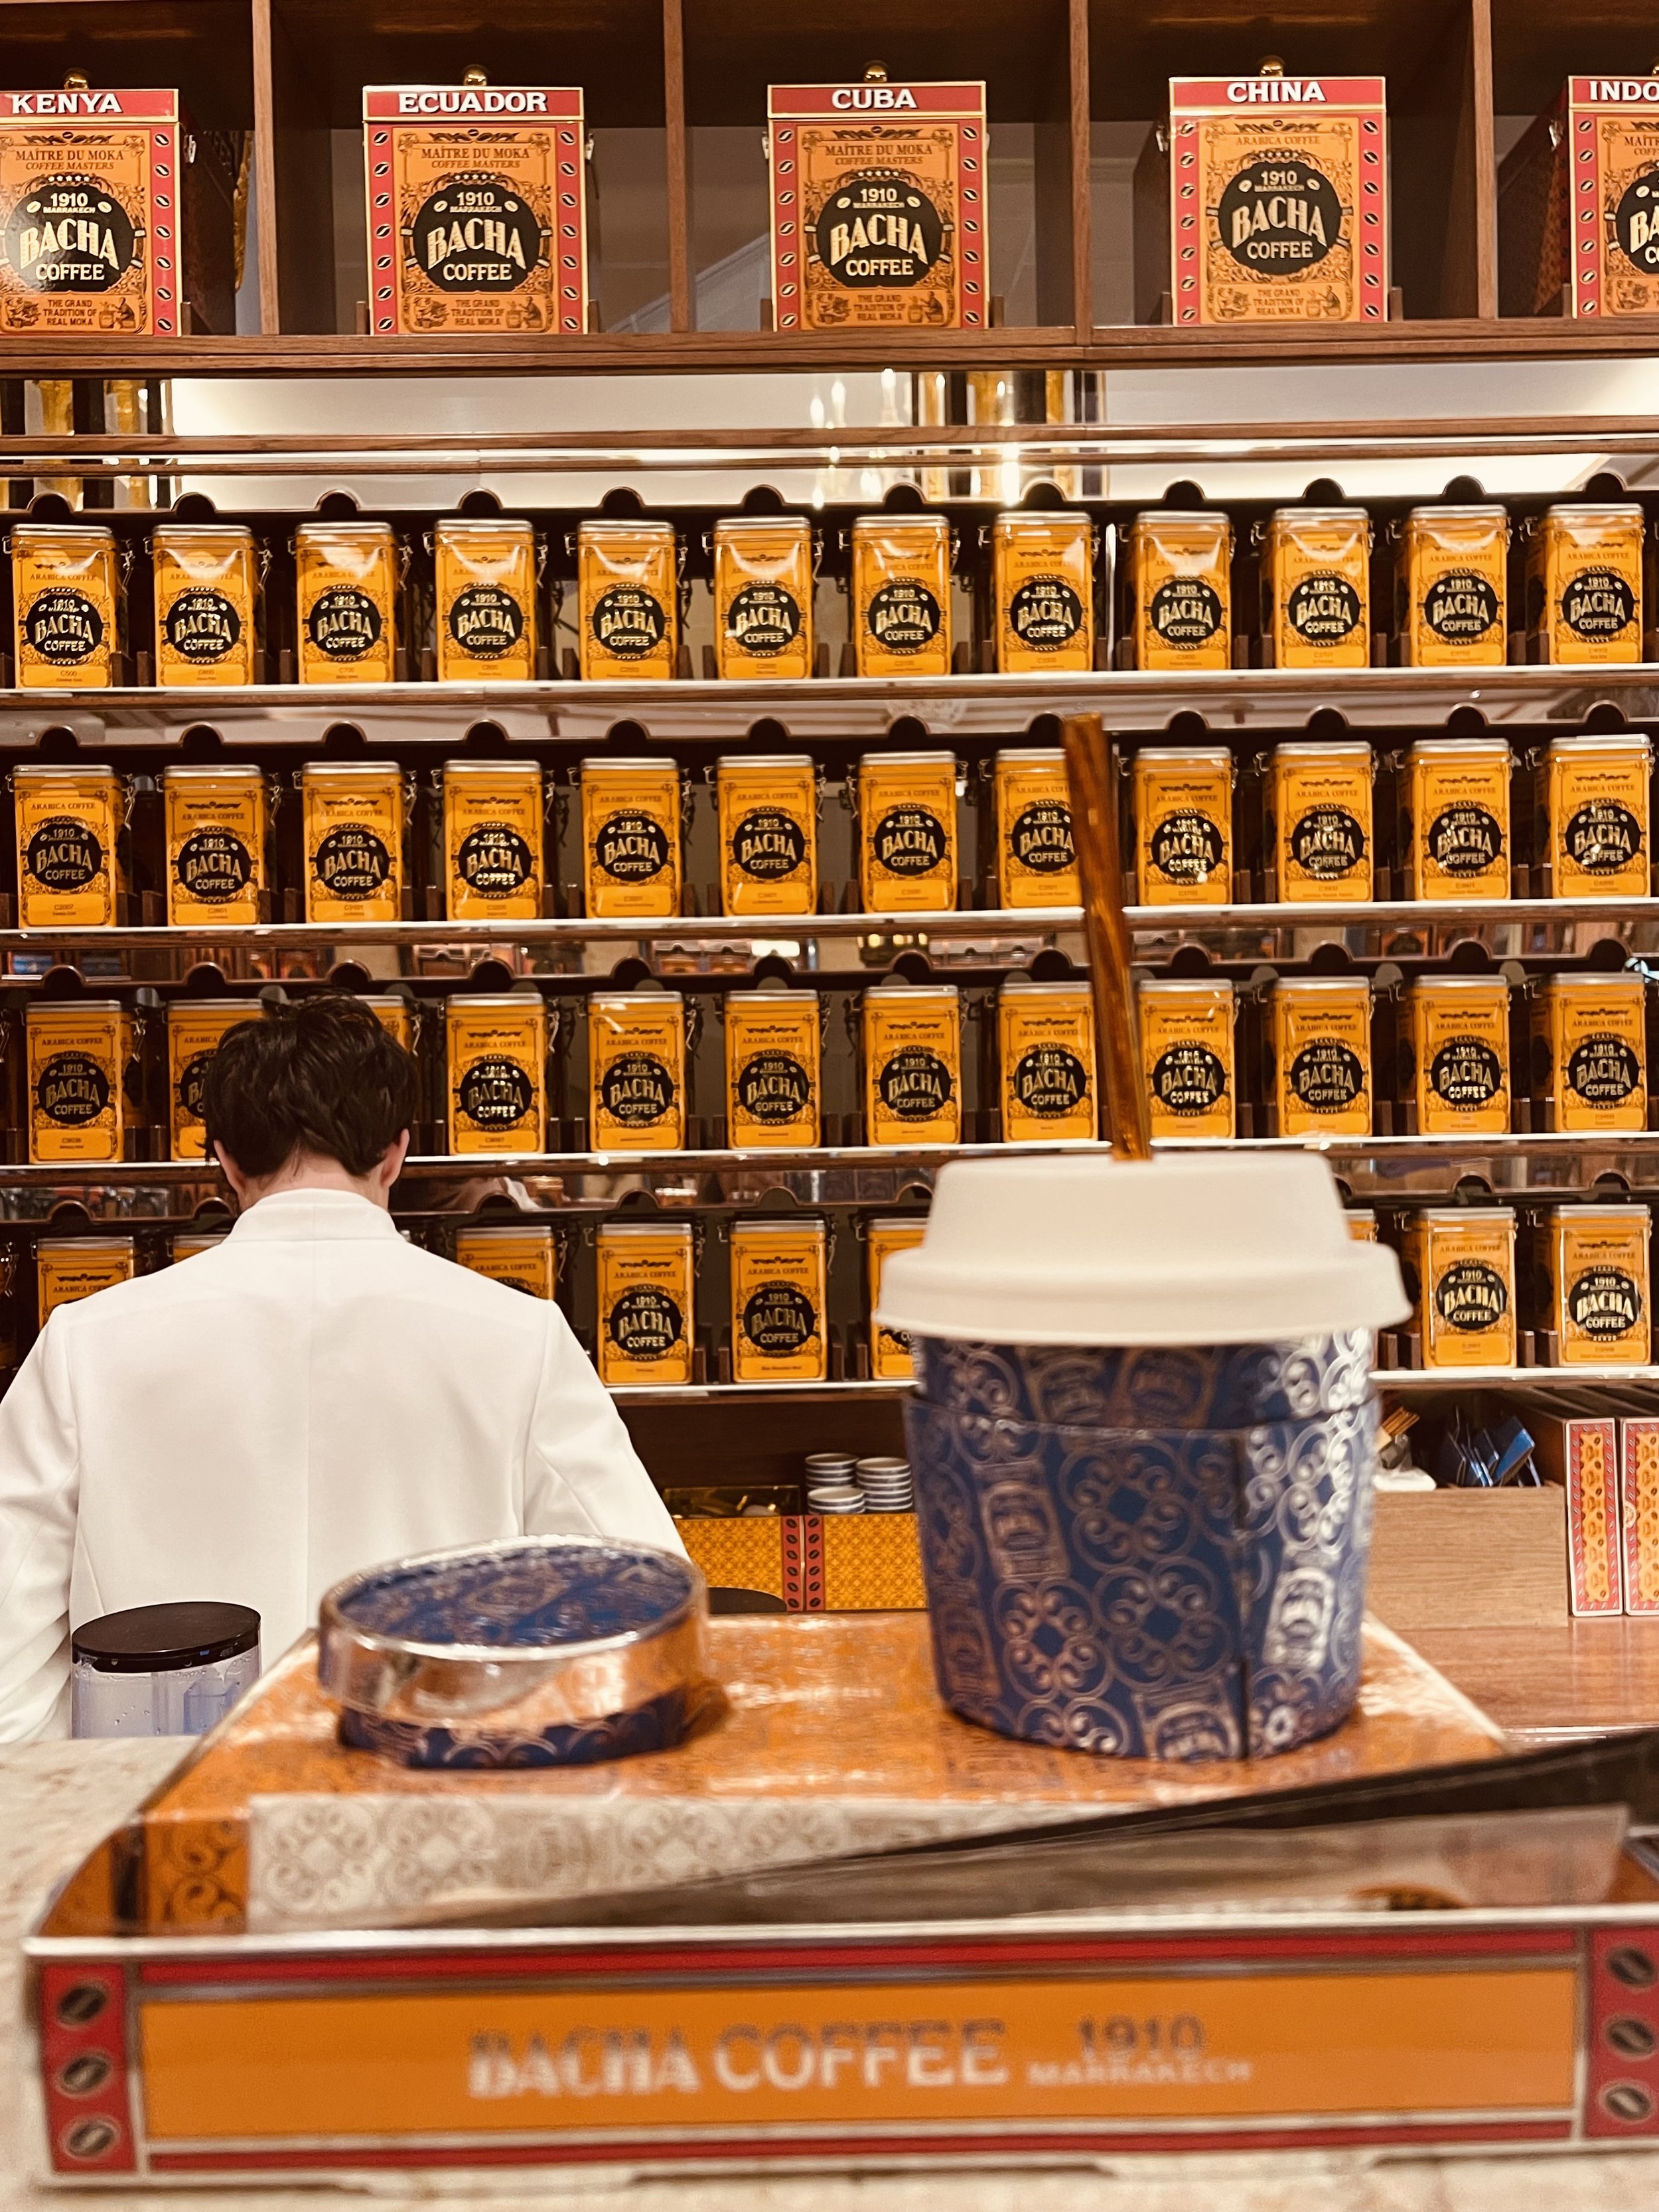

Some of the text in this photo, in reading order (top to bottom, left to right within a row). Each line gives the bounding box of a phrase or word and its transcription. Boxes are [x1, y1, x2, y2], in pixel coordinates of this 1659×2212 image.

[1227, 81, 1326, 102] CHINA
[12, 93, 122, 114] KENYA
[398, 92, 547, 113] ECUADOR
[831, 89, 917, 110] CUBA
[1236, 135, 1321, 145] ARABICA COFFEE
[15, 148, 124, 161] MAÎTRE DU MOKA
[421, 146, 530, 159] MAÎTRE DU MOKA
[825, 143, 932, 156] MAÎTRE DU MOKA
[25, 161, 114, 171] COFFEE MASTERS
[431, 160, 520, 169] COFFEE MASTERS
[875, 156, 924, 165] MASTERS
[1261, 171, 1297, 185] 1910
[50, 192, 88, 206] 1910
[457, 192, 495, 206] 1910
[860, 188, 897, 202] 1910
[1232, 196, 1327, 249] BACHA
[20, 218, 119, 270] BACHA
[427, 218, 527, 270] BACHA
[830, 214, 928, 265] BACHA
[1246, 241, 1313, 259] COFFEE
[36, 263, 105, 281] COFFEE
[443, 263, 512, 281] COFFEE
[845, 259, 914, 276] COFFEE
[1257, 289, 1271, 297] THE
[48, 299, 93, 308] THE GRAND
[455, 299, 500, 308] THE GRAND
[1295, 298, 1305, 307] OF
[42, 309, 97, 317] TRADITION OF
[451, 309, 505, 317] TRADITION OF
[474, 593, 497, 603] 1910
[893, 589, 914, 598] 1910
[1296, 597, 1352, 626] BACHA
[1433, 594, 1488, 626] BACHA
[1570, 592, 1625, 621] BACHA
[876, 604, 932, 632] BACHA
[1018, 601, 1074, 632] BACHA
[1159, 600, 1213, 630] BACHA
[317, 612, 372, 644] BACHA
[457, 609, 515, 638] BACHA
[601, 610, 657, 639] BACHA
[735, 607, 792, 638] BACHA
[1305, 621, 1344, 633] COFFEE
[1441, 620, 1481, 632] COFFEE
[1579, 618, 1618, 630] COFFEE
[35, 614, 93, 645] BACHA
[175, 614, 230, 645] BACHA
[885, 629, 924, 641] COFFEE
[1027, 625, 1066, 638] COFFEE
[1167, 625, 1206, 636] COFFEE
[326, 636, 366, 649] COFFEE
[467, 634, 507, 646] COFFEE
[609, 635, 649, 646] COFFEE
[745, 632, 784, 643] COFFEE
[44, 638, 86, 652] COFFEE
[183, 638, 224, 651] COFFEE
[621, 822, 642, 831] 1910
[758, 819, 779, 828] 1910
[53, 828, 74, 838] 1910
[882, 830, 937, 860] BACHA
[1020, 827, 1074, 857] BACHA
[1300, 830, 1354, 859] BACHA
[1437, 827, 1492, 859] BACHA
[1574, 826, 1630, 856] BACHA
[604, 836, 660, 865] BACHA
[741, 834, 796, 863] BACHA
[1159, 833, 1214, 863] BACHA
[36, 844, 93, 875] BACHA
[467, 848, 524, 877] BACHA
[891, 855, 930, 865] COFFEE
[1029, 851, 1068, 863] COFFEE
[1309, 855, 1348, 867] COFFEE
[1445, 852, 1485, 865] COFFEE
[186, 853, 242, 883] BACHA
[325, 850, 381, 881] BACHA
[613, 861, 653, 872] COFFEE
[750, 859, 789, 870] COFFEE
[45, 869, 86, 881] COFFEE
[333, 875, 373, 887] COFFEE
[475, 873, 516, 885] COFFEE
[195, 879, 235, 889] COFFEE
[62, 1065, 83, 1074] 1910
[763, 1062, 784, 1071] 1910
[1161, 1065, 1216, 1096] BACHA
[1299, 1064, 1354, 1094] BACHA
[1439, 1062, 1494, 1093] BACHA
[1577, 1059, 1631, 1090] BACHA
[887, 1072, 942, 1101] BACHA
[1022, 1069, 1078, 1100] BACHA
[1585, 1084, 1624, 1096] COFFEE
[46, 1078, 100, 1108] BACHA
[468, 1080, 524, 1111] BACHA
[610, 1078, 664, 1110] BACHA
[747, 1076, 802, 1108] BACHA
[1170, 1091, 1209, 1104] COFFEE
[1308, 1089, 1346, 1101] COFFEE
[1448, 1086, 1486, 1099] COFFEE
[755, 1100, 793, 1112] COFFEE
[896, 1097, 935, 1108] COFFEE
[1031, 1094, 1070, 1105] COFFEE
[54, 1104, 92, 1115] COFFEE
[476, 1105, 516, 1118] COFFEE
[618, 1104, 657, 1114] COFFEE
[1461, 1270, 1482, 1280] 1910
[1595, 1277, 1615, 1287] 1910
[769, 1293, 790, 1303] 1910
[1444, 1285, 1500, 1315] BACHA
[1576, 1292, 1634, 1322] BACHA
[752, 1307, 807, 1337] BACHA
[1453, 1310, 1491, 1322] COFFEE
[1586, 1316, 1625, 1328] COFFEE
[619, 1310, 673, 1341] BACHA
[626, 1337, 665, 1347] COFFEE
[760, 1333, 798, 1343] COFFEE
[1075, 2014, 1206, 2053] 1910
[468, 2018, 1007, 2099] BACHA COFFEE
[1026, 2057, 1252, 2087] MARRAKECH
